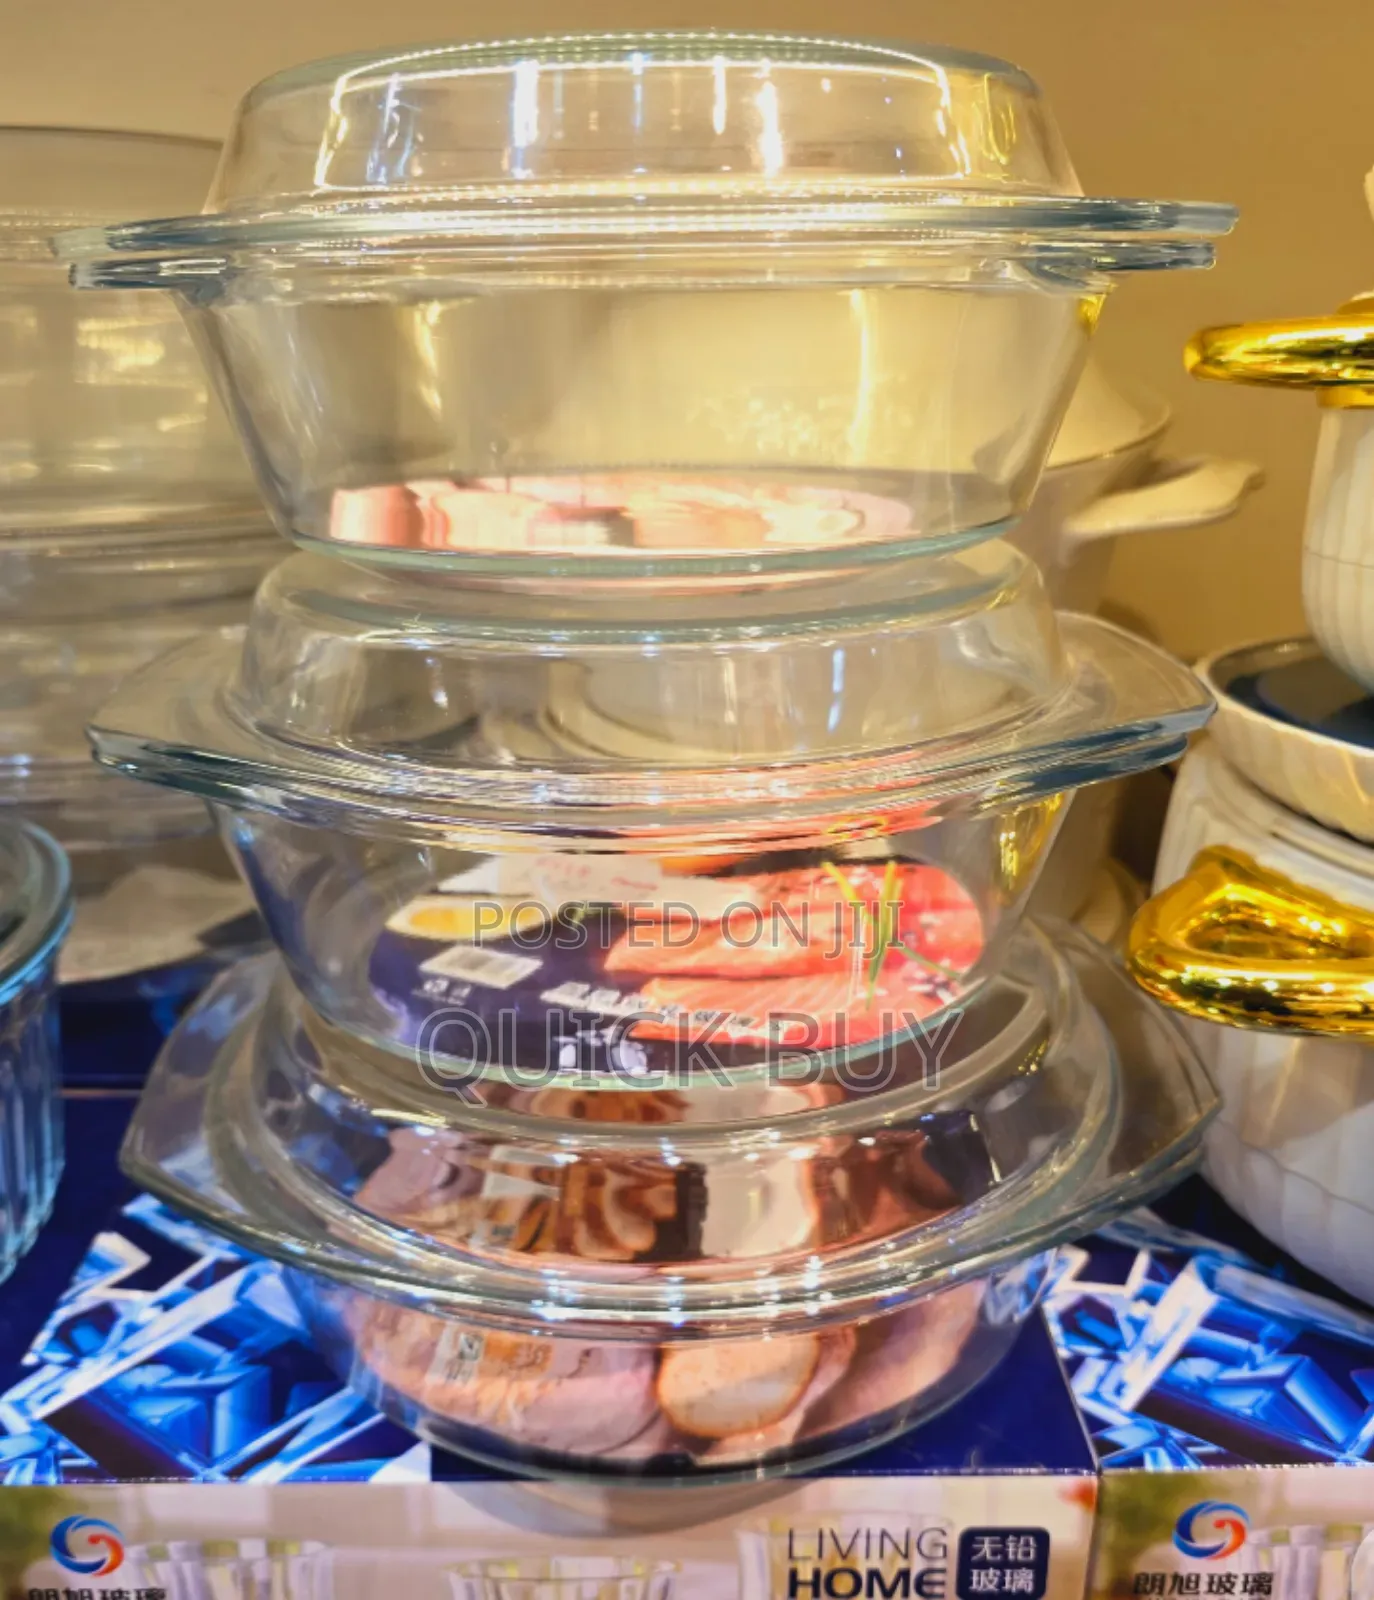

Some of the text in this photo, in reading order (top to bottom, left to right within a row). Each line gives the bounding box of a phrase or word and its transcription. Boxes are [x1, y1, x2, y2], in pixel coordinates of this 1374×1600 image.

[788, 1527, 947, 1561] LIVING
[971, 1534, 1038, 1562] 无铅
[788, 1567, 947, 1599] HOME
[969, 1567, 1036, 1595] 玻璃
[1133, 1572, 1275, 1596] 朗旭玻璃
